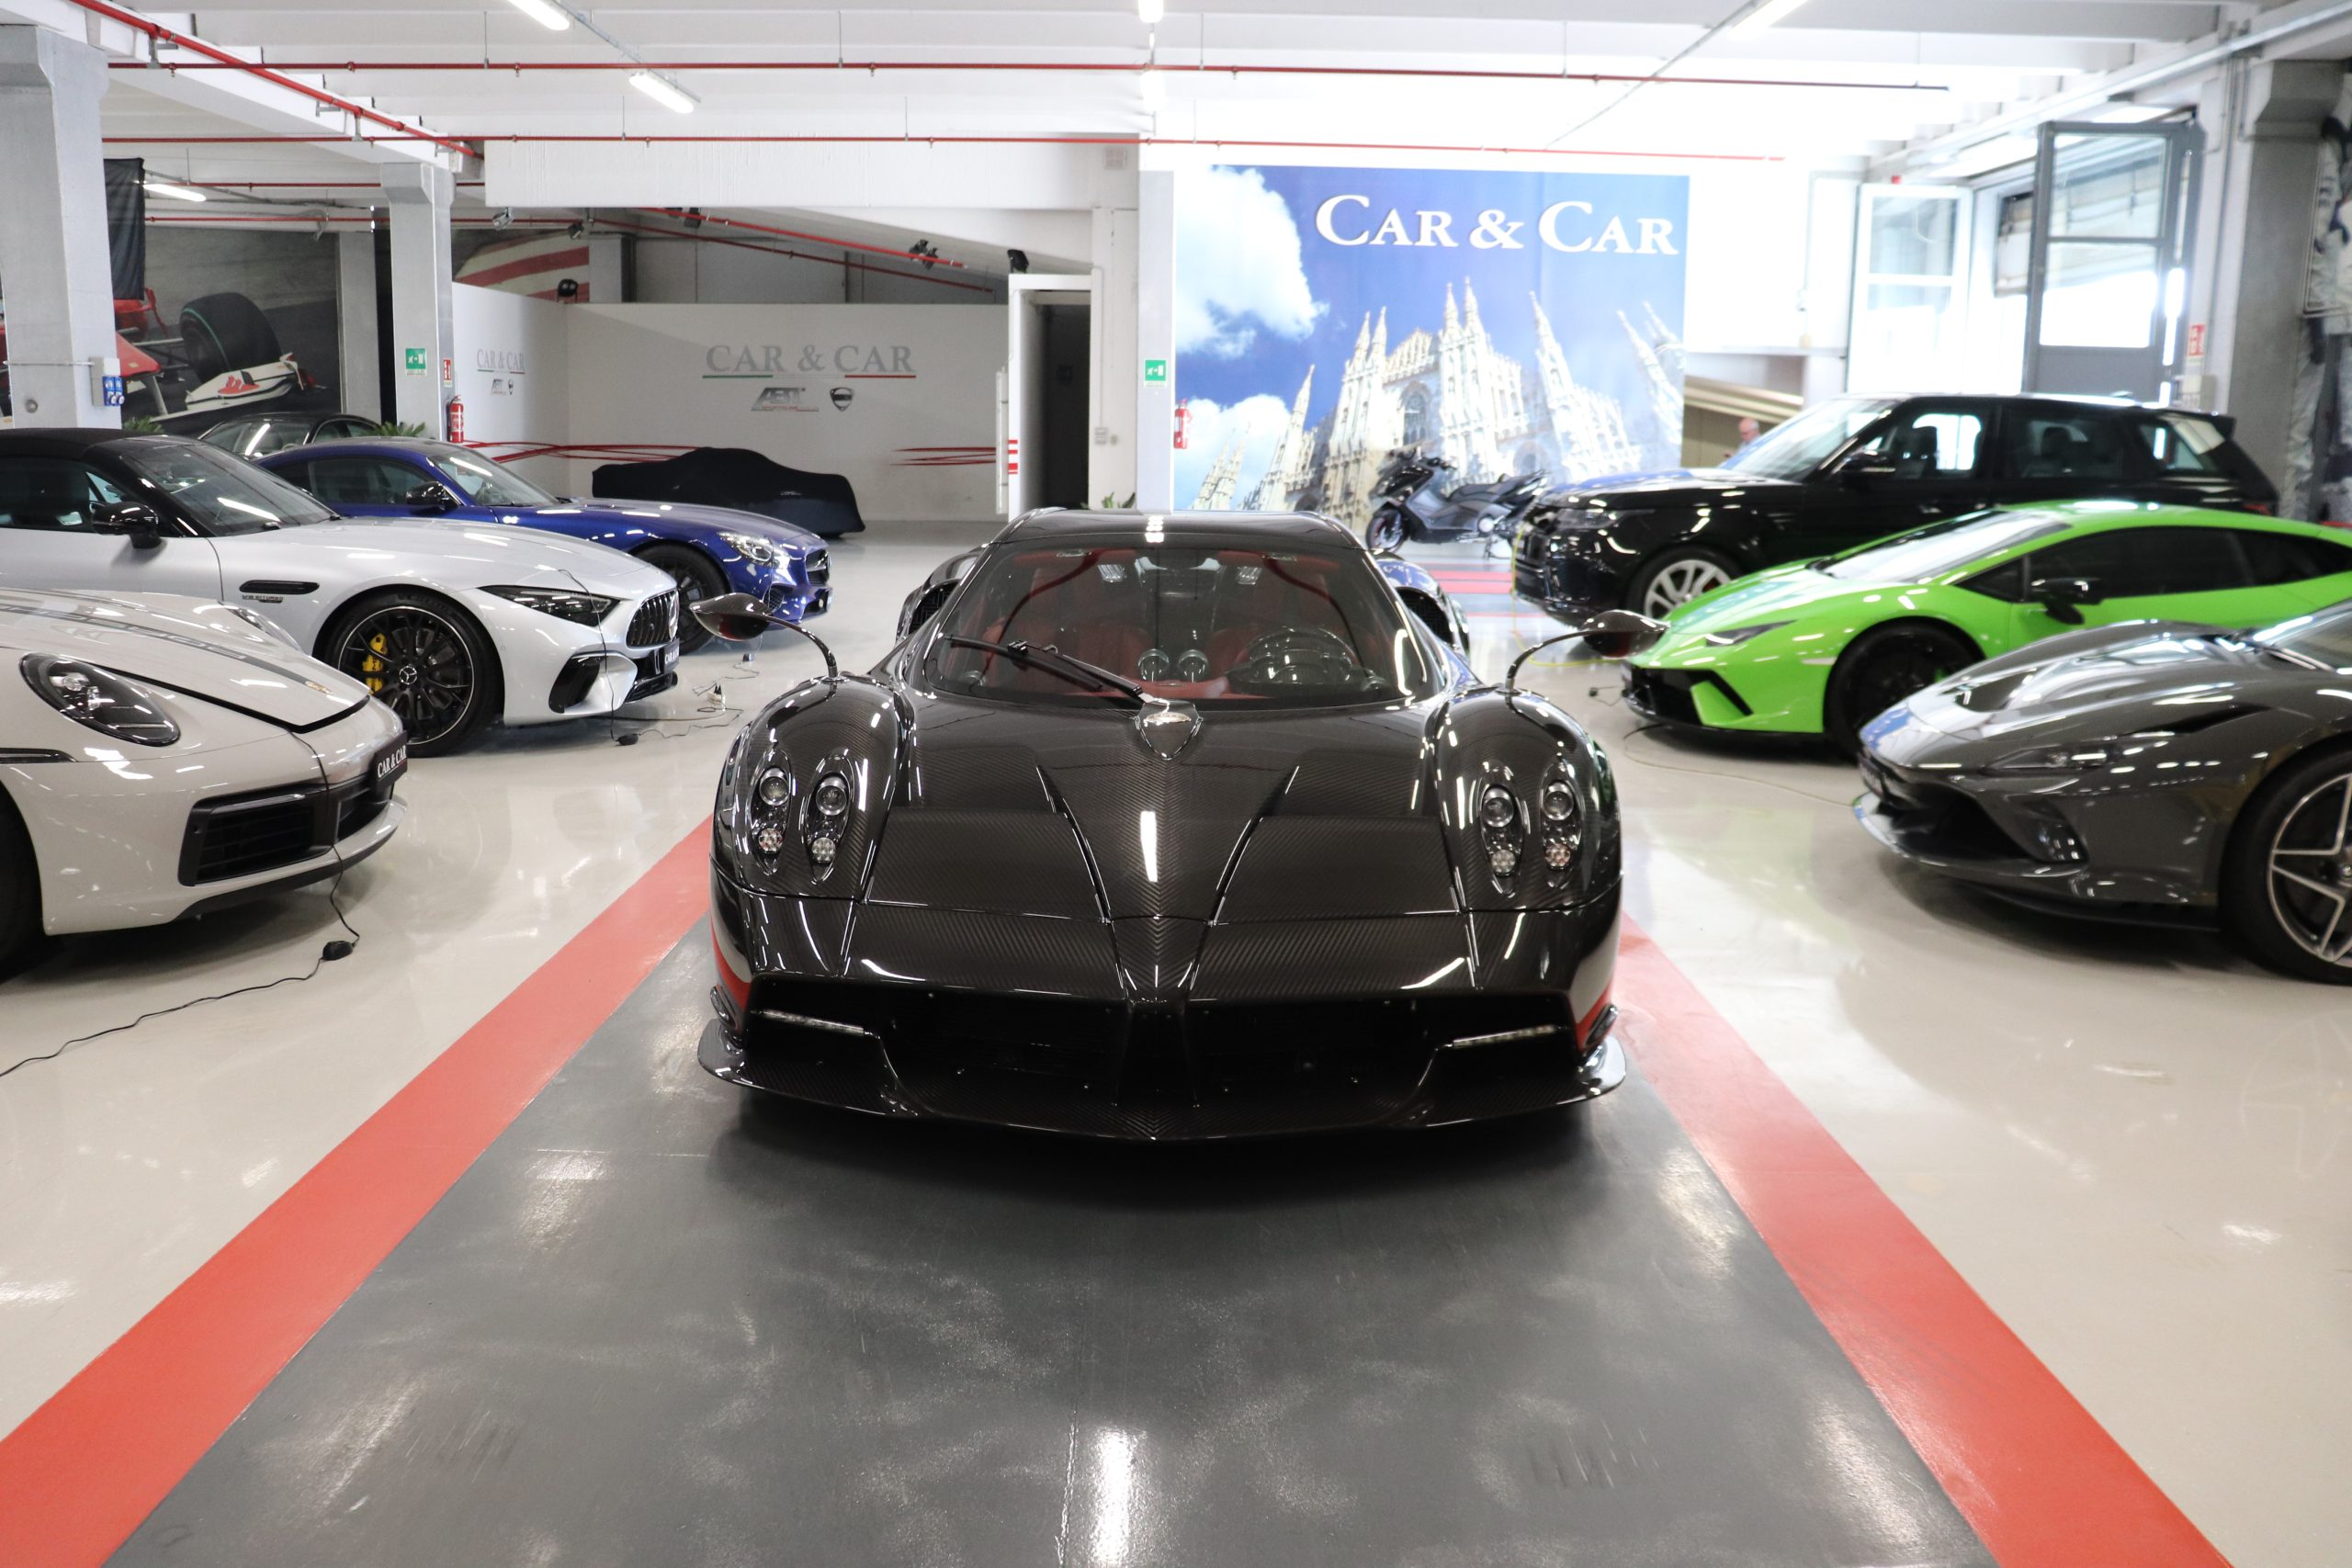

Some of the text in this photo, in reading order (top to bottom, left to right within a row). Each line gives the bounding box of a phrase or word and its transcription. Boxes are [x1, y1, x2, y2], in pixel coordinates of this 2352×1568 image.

[1315, 194, 1679, 255] CAR & CAR
[477, 349, 496, 368] CAR
[506, 352, 525, 371] CAR
[705, 344, 915, 373] CAR & CAR
[378, 744, 407, 778] CAR & CAR
